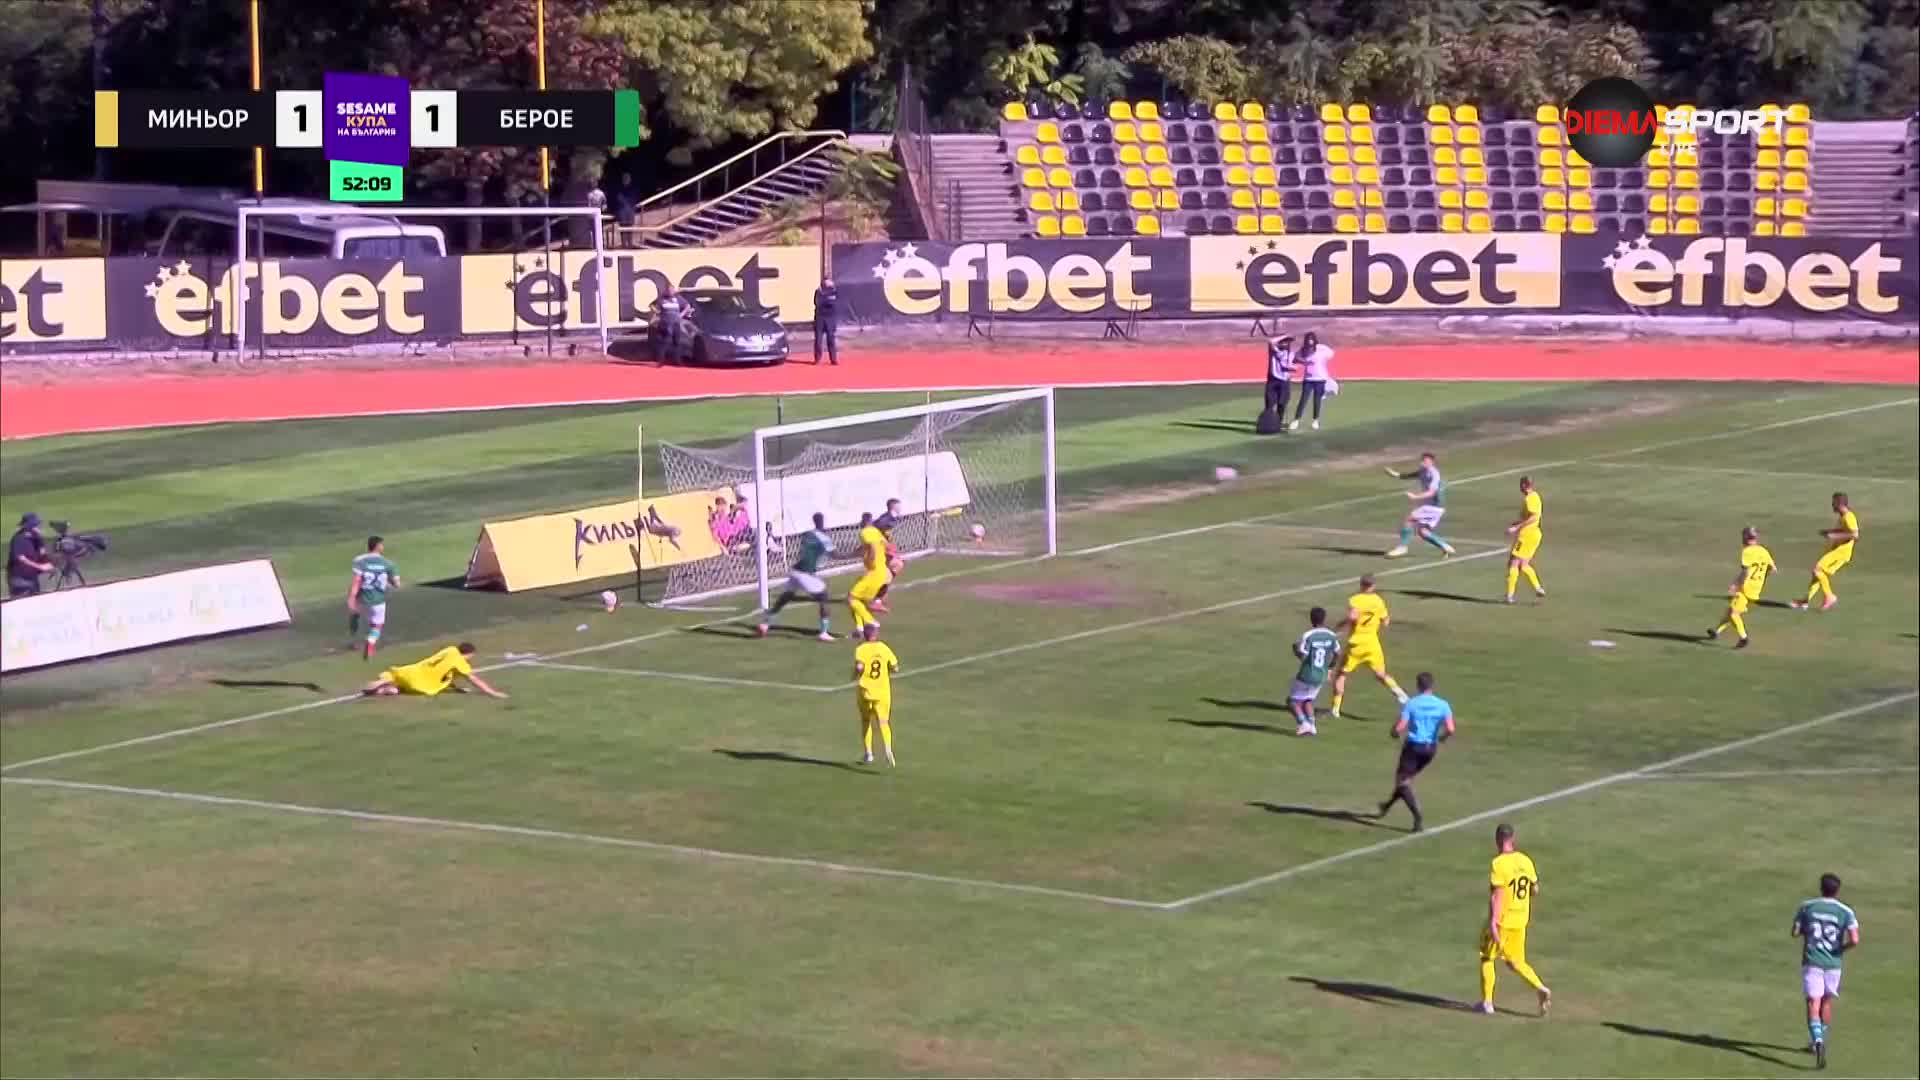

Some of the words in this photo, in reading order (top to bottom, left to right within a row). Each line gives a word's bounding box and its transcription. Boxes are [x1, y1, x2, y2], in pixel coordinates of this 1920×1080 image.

[884, 241, 1152, 315] efbet
[1245, 238, 1517, 306] efbet
[1612, 237, 1902, 312] efbet
[156, 260, 425, 336] efbet
[1361, 611, 1375, 626] 7
[870, 659, 881, 680] 8
[1313, 648, 1326, 668] 8
[1508, 875, 1529, 901] 18
